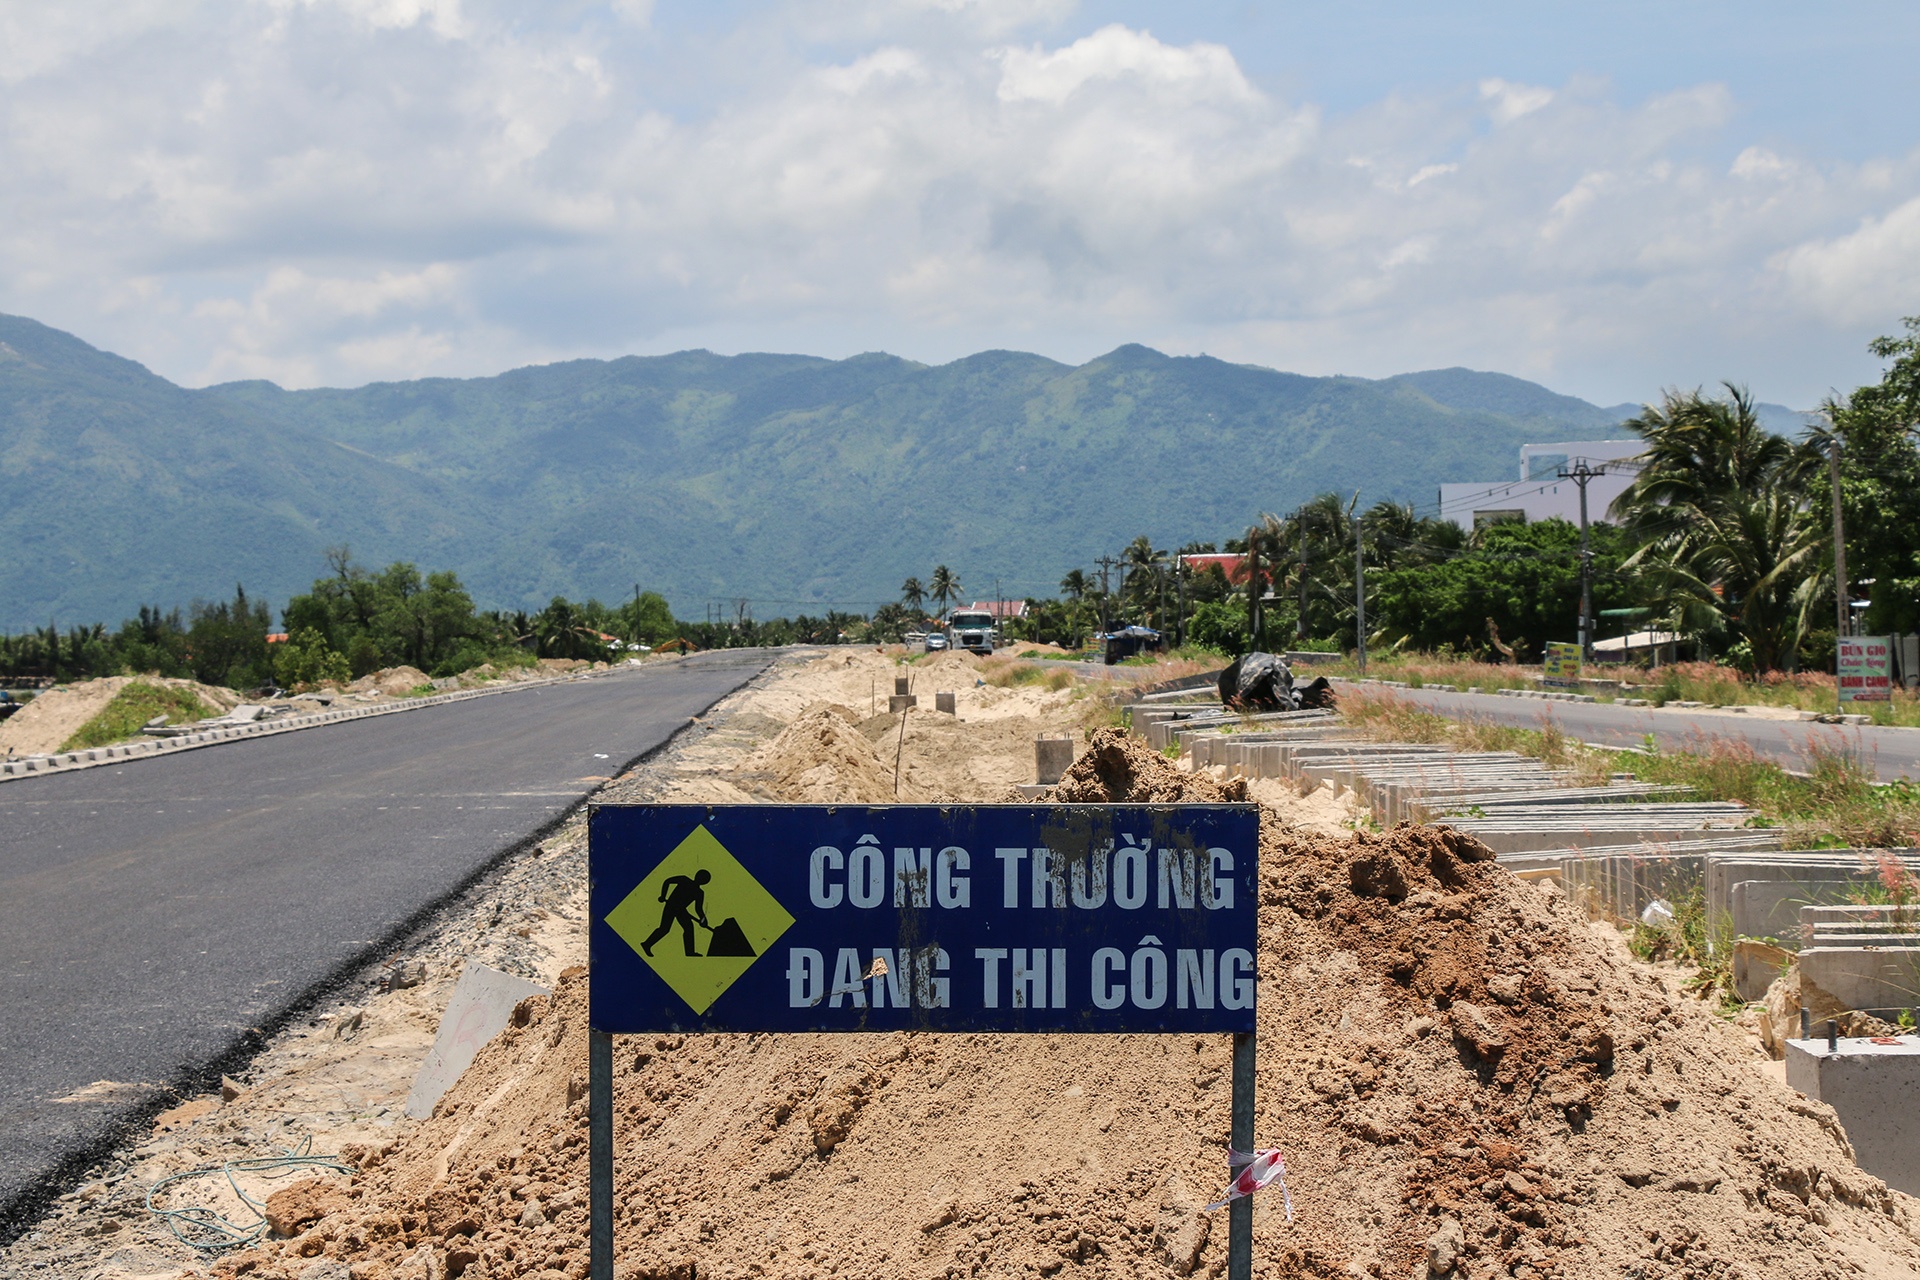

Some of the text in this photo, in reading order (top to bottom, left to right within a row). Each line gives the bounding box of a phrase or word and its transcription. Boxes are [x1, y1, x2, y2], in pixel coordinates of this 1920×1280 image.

[809, 833, 1235, 910] CÔNG TRƯỜNG
[786, 935, 1254, 1011] ĐANG THI CÔNG
